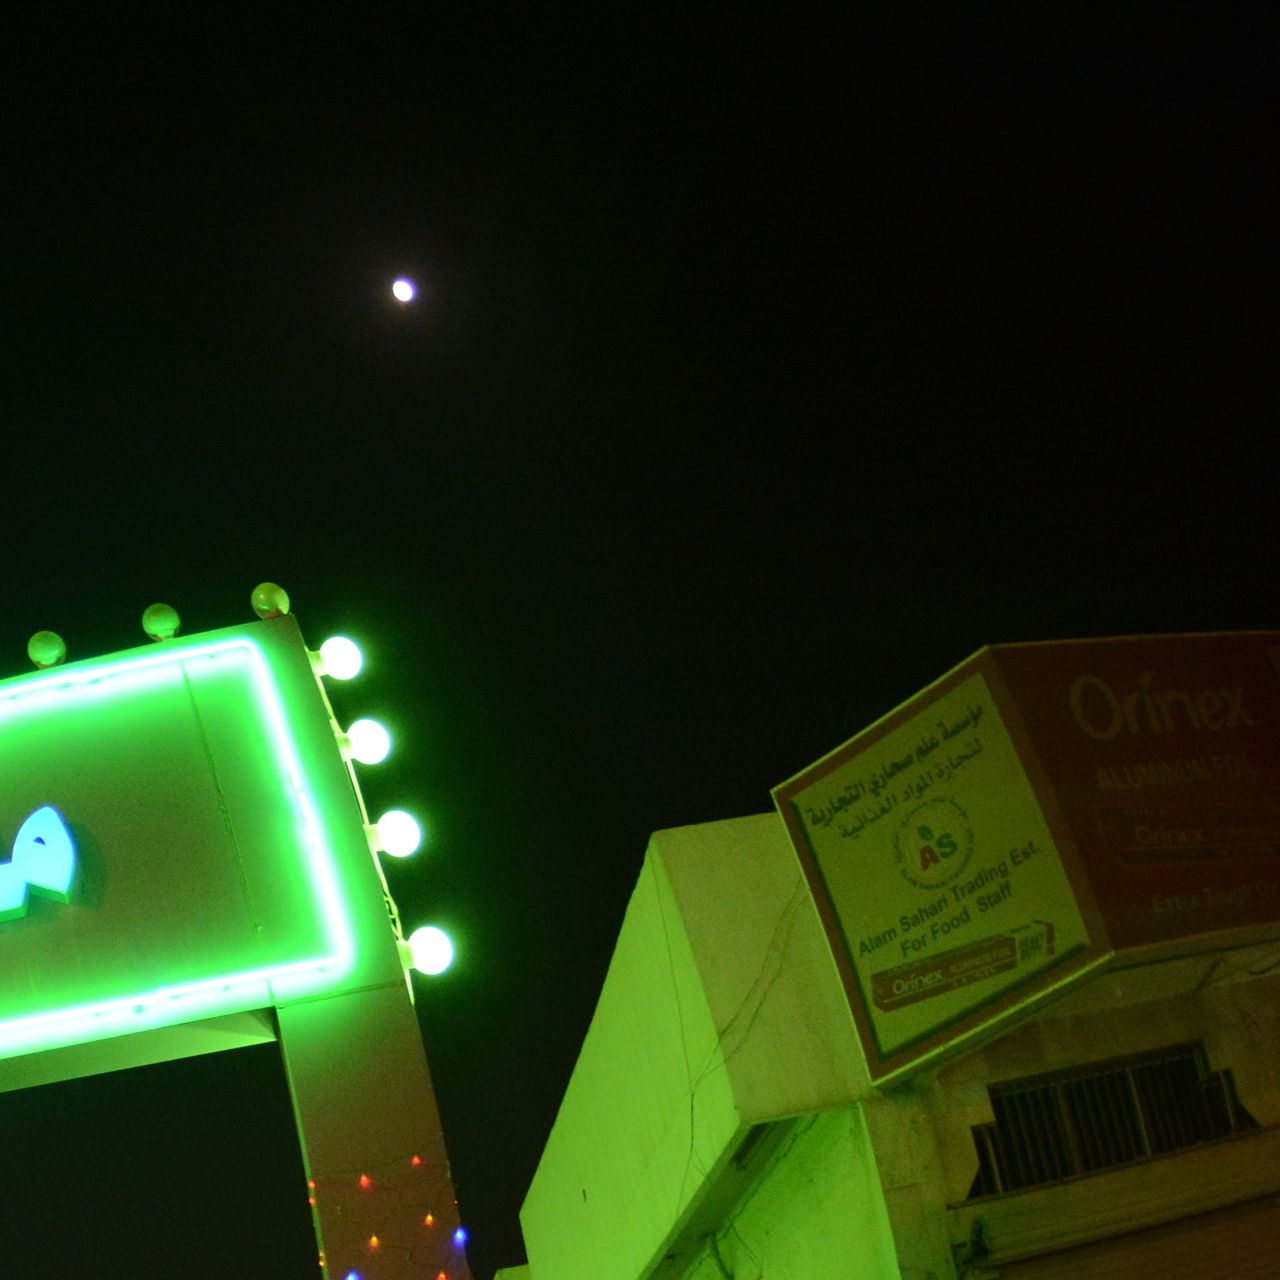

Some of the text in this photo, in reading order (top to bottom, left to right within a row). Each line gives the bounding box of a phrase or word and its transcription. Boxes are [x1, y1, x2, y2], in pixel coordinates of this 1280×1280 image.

[1069, 672, 1255, 741] Orinex
[858, 925, 897, 958] Alam
[900, 895, 949, 929] Sahari
[951, 862, 1010, 903] Trading
[900, 881, 1015, 957] For Food Staff
[892, 968, 945, 995] Orinex
